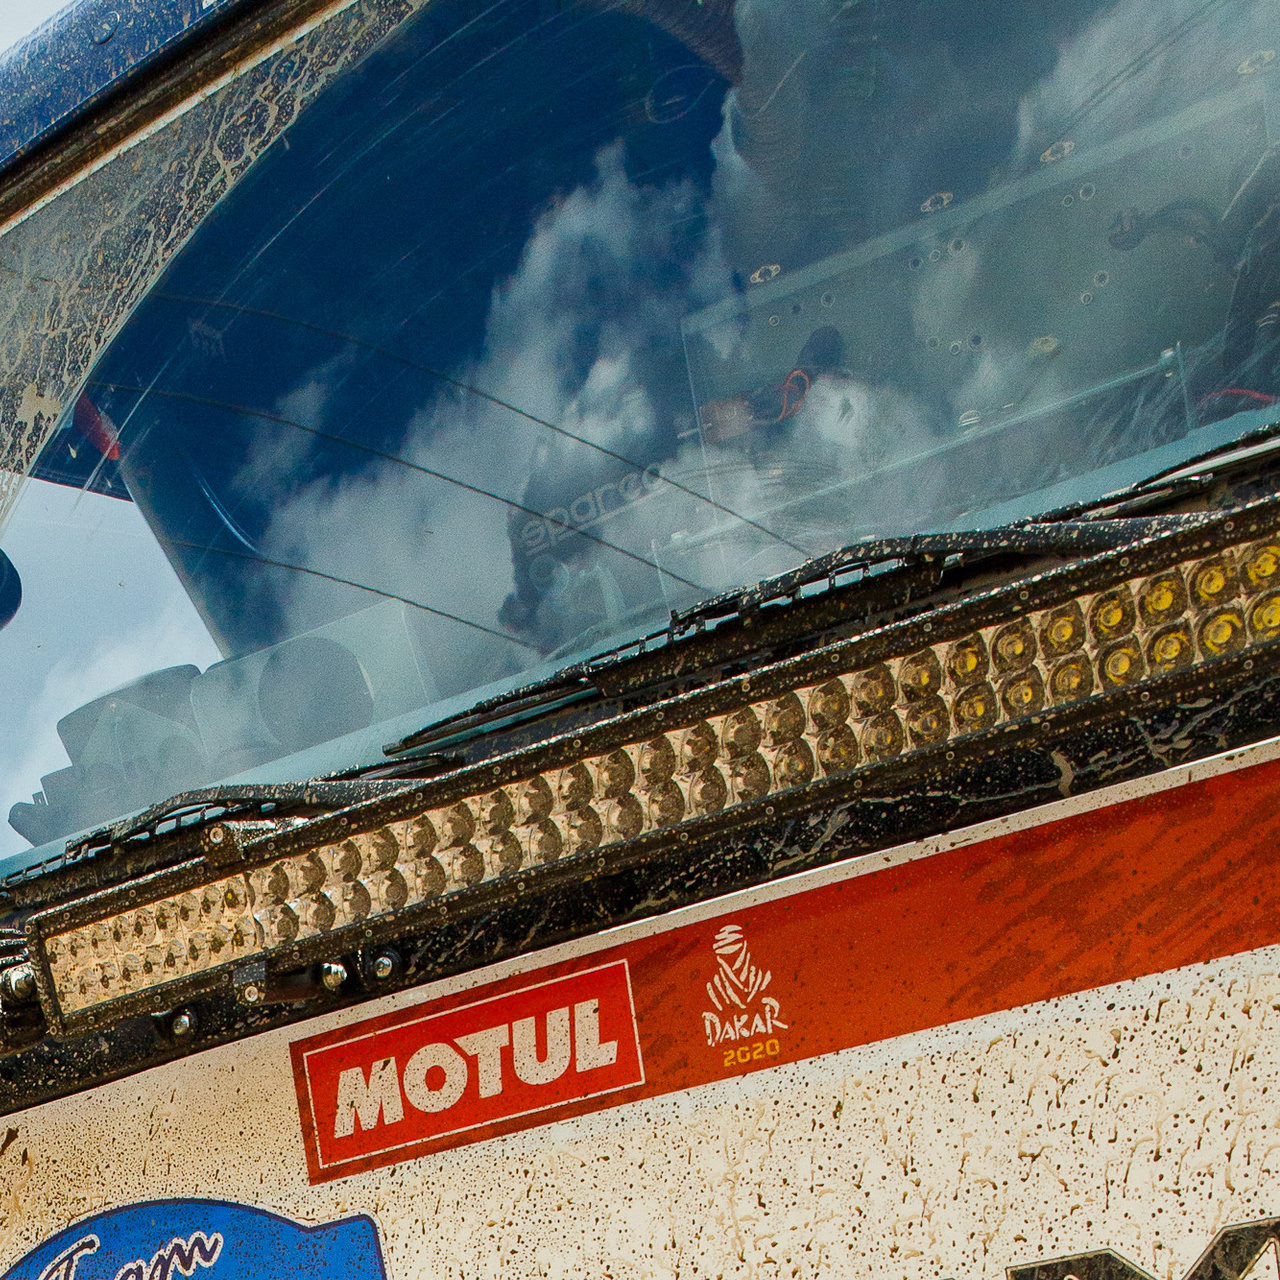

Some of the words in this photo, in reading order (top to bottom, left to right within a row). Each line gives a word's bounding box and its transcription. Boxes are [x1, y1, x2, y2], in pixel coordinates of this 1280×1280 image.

[701, 996, 789, 1048] DAKAR
[334, 998, 619, 1139] MOTUL
[723, 1038, 780, 1067] 2020
